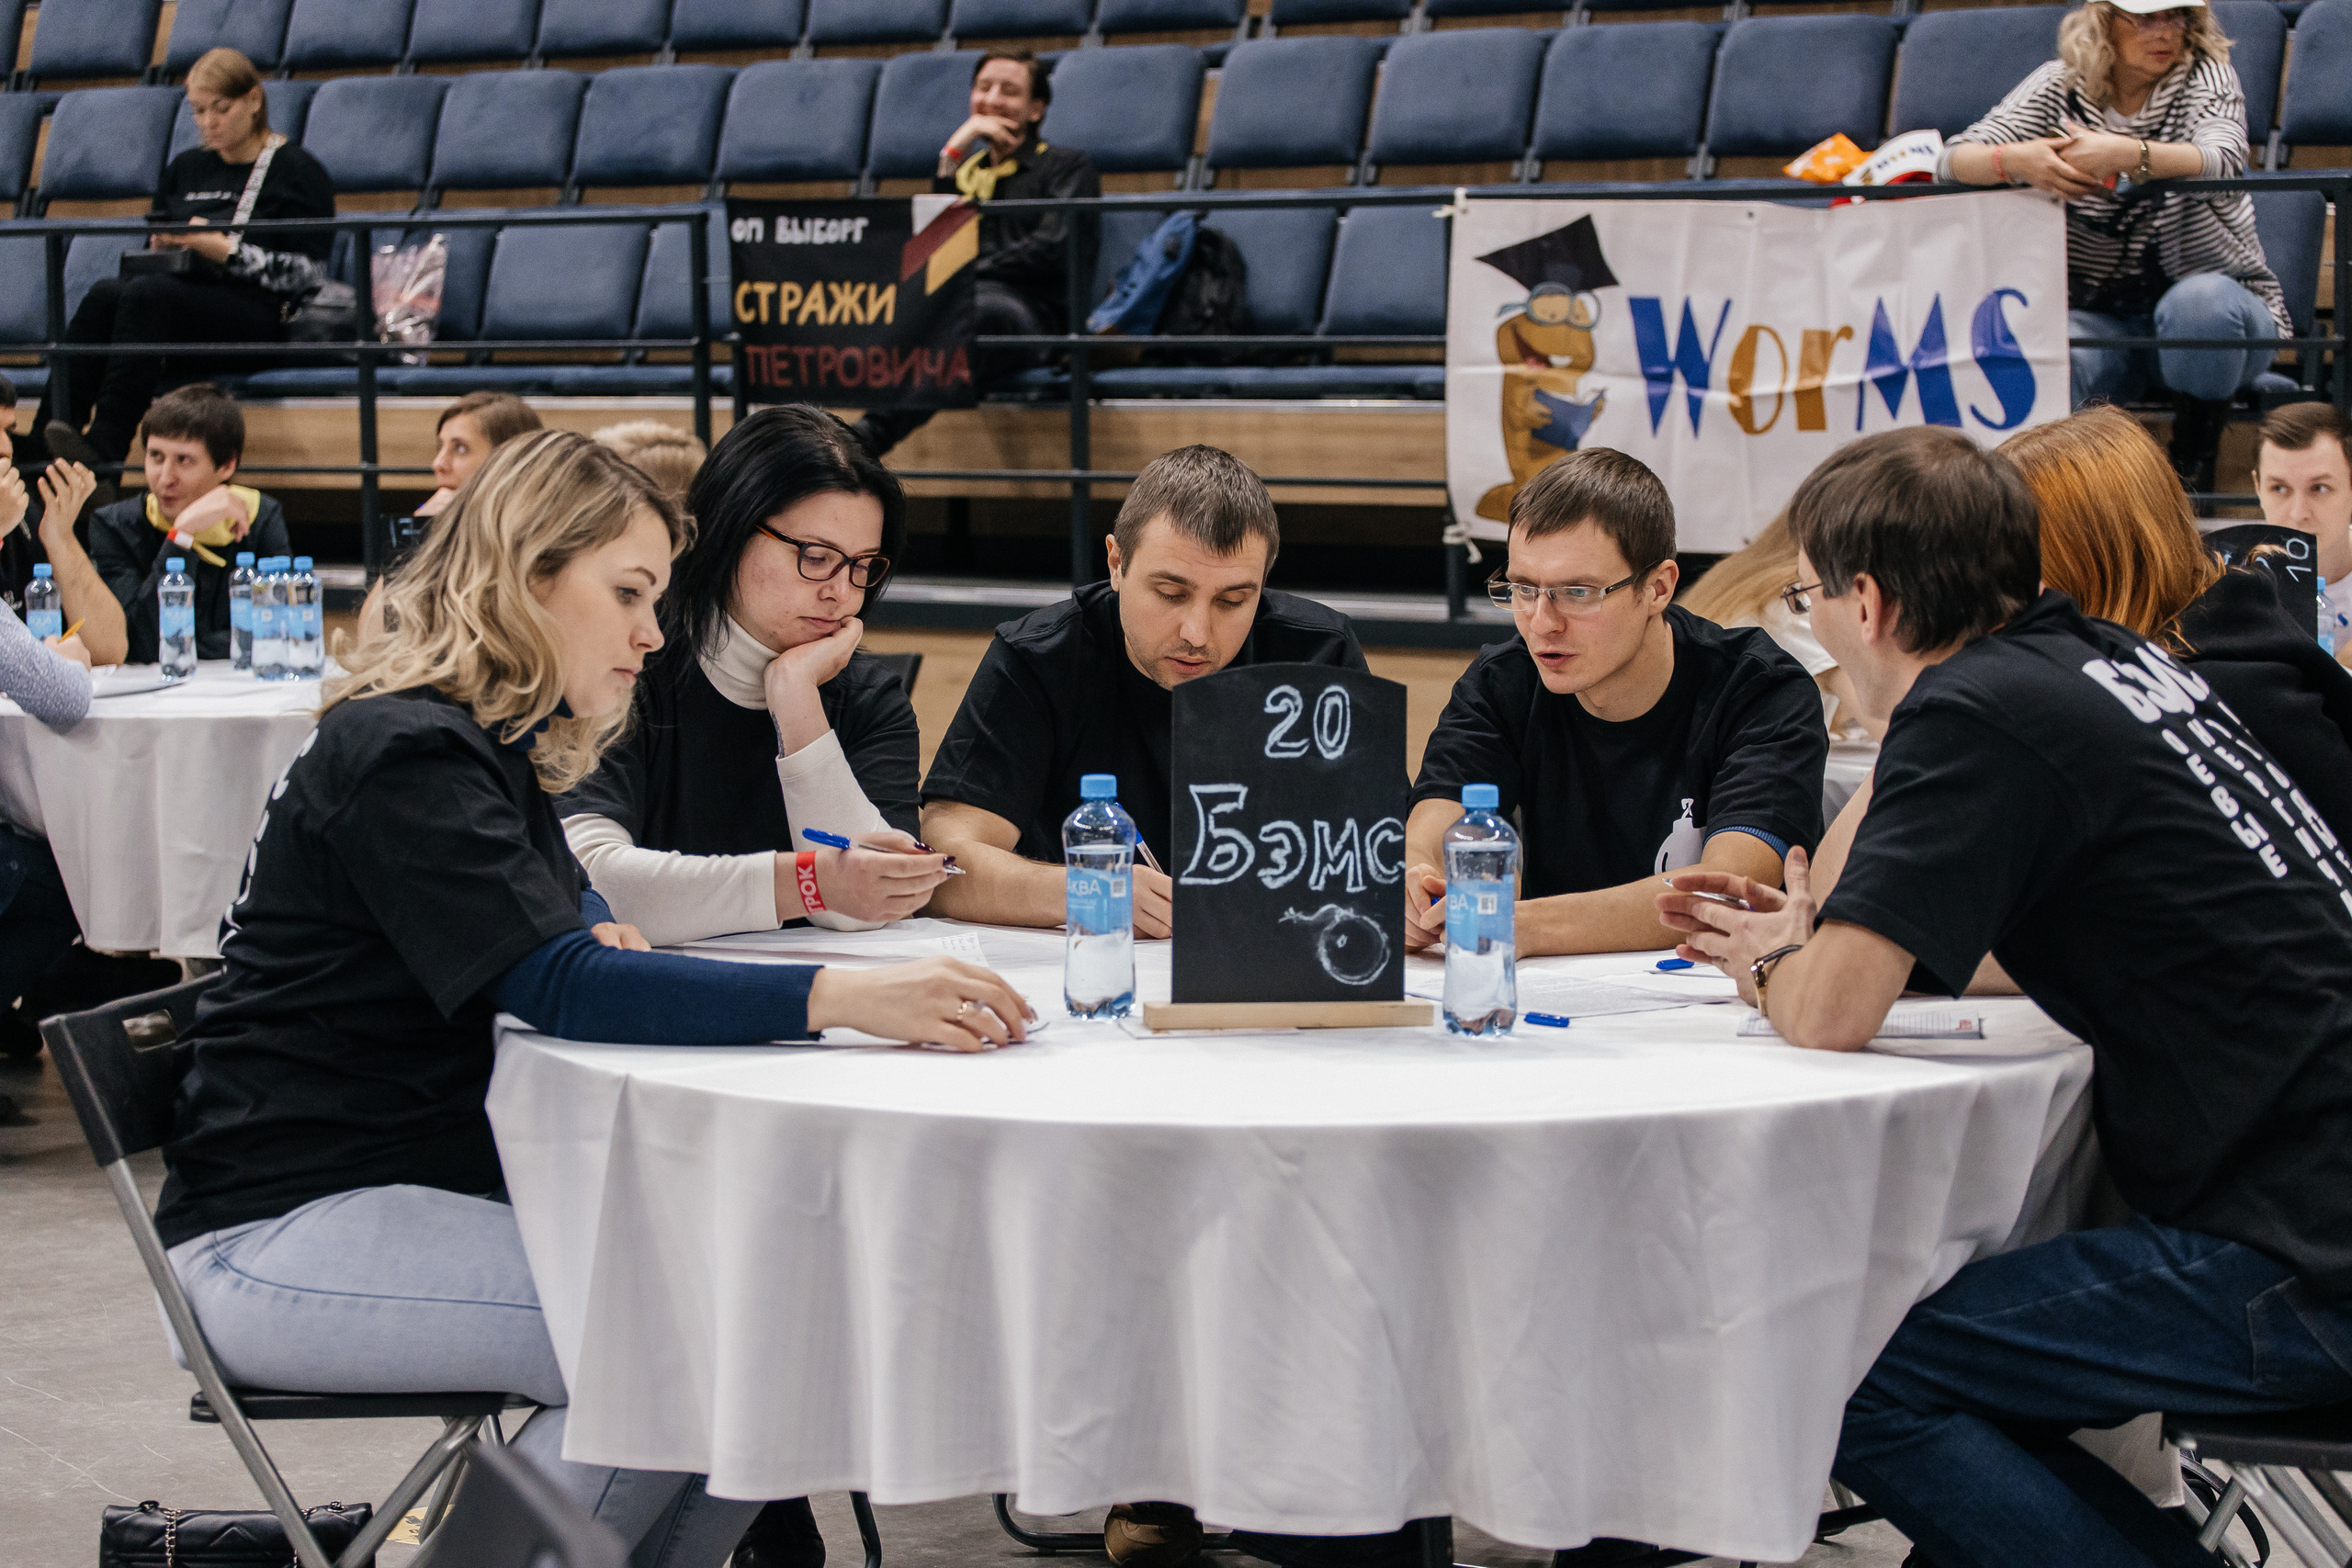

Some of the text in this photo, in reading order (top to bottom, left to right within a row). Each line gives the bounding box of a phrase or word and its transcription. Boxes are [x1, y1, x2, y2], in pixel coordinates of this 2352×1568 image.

[731, 216, 869, 244] ОП ВЫБОРГ
[735, 280, 898, 325] СТРАЖИ
[745, 344, 972, 388] ПЕТРОВИЧА
[2285, 537, 2312, 582] 10
[1263, 684, 1351, 761] 20
